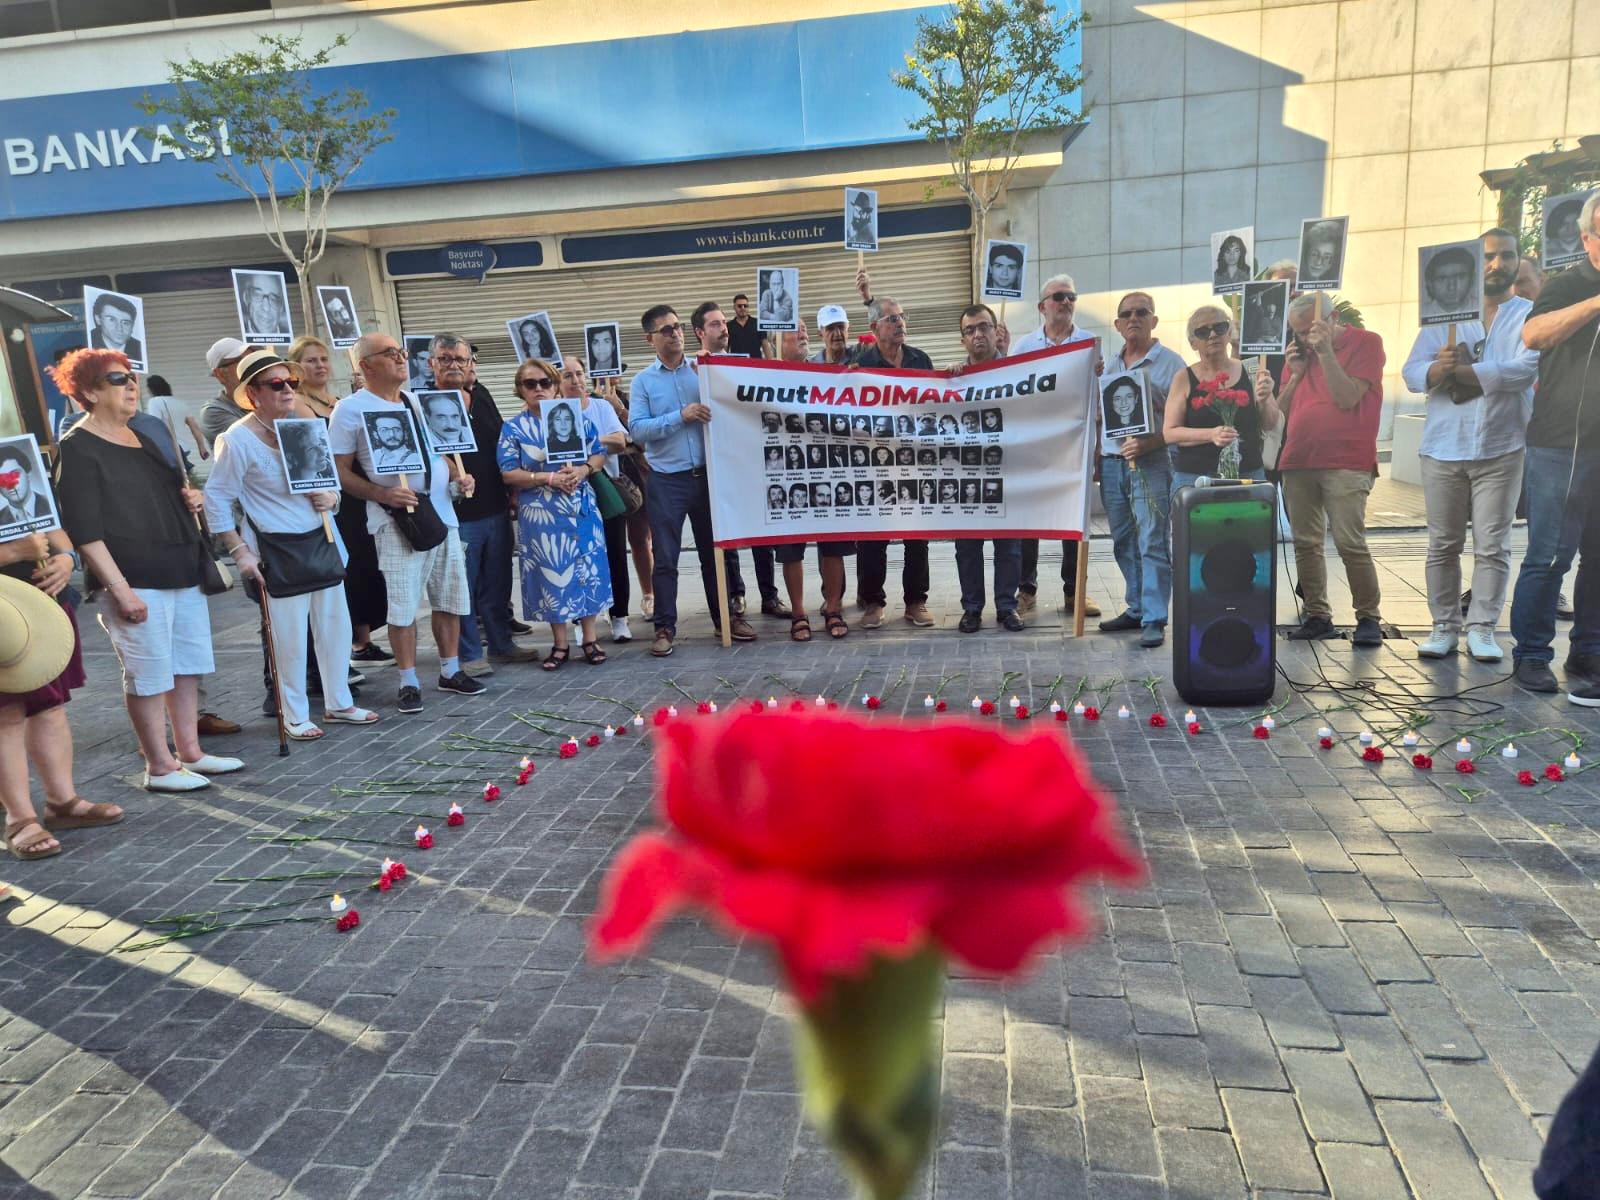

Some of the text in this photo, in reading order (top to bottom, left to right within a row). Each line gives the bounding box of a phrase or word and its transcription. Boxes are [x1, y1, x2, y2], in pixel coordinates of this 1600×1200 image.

[4, 117, 232, 175] BANKASI
[695, 226, 826, 247] www.isbank.com.tr
[448, 250, 484, 260] Başvuru
[450, 260, 484, 271] Noktası
